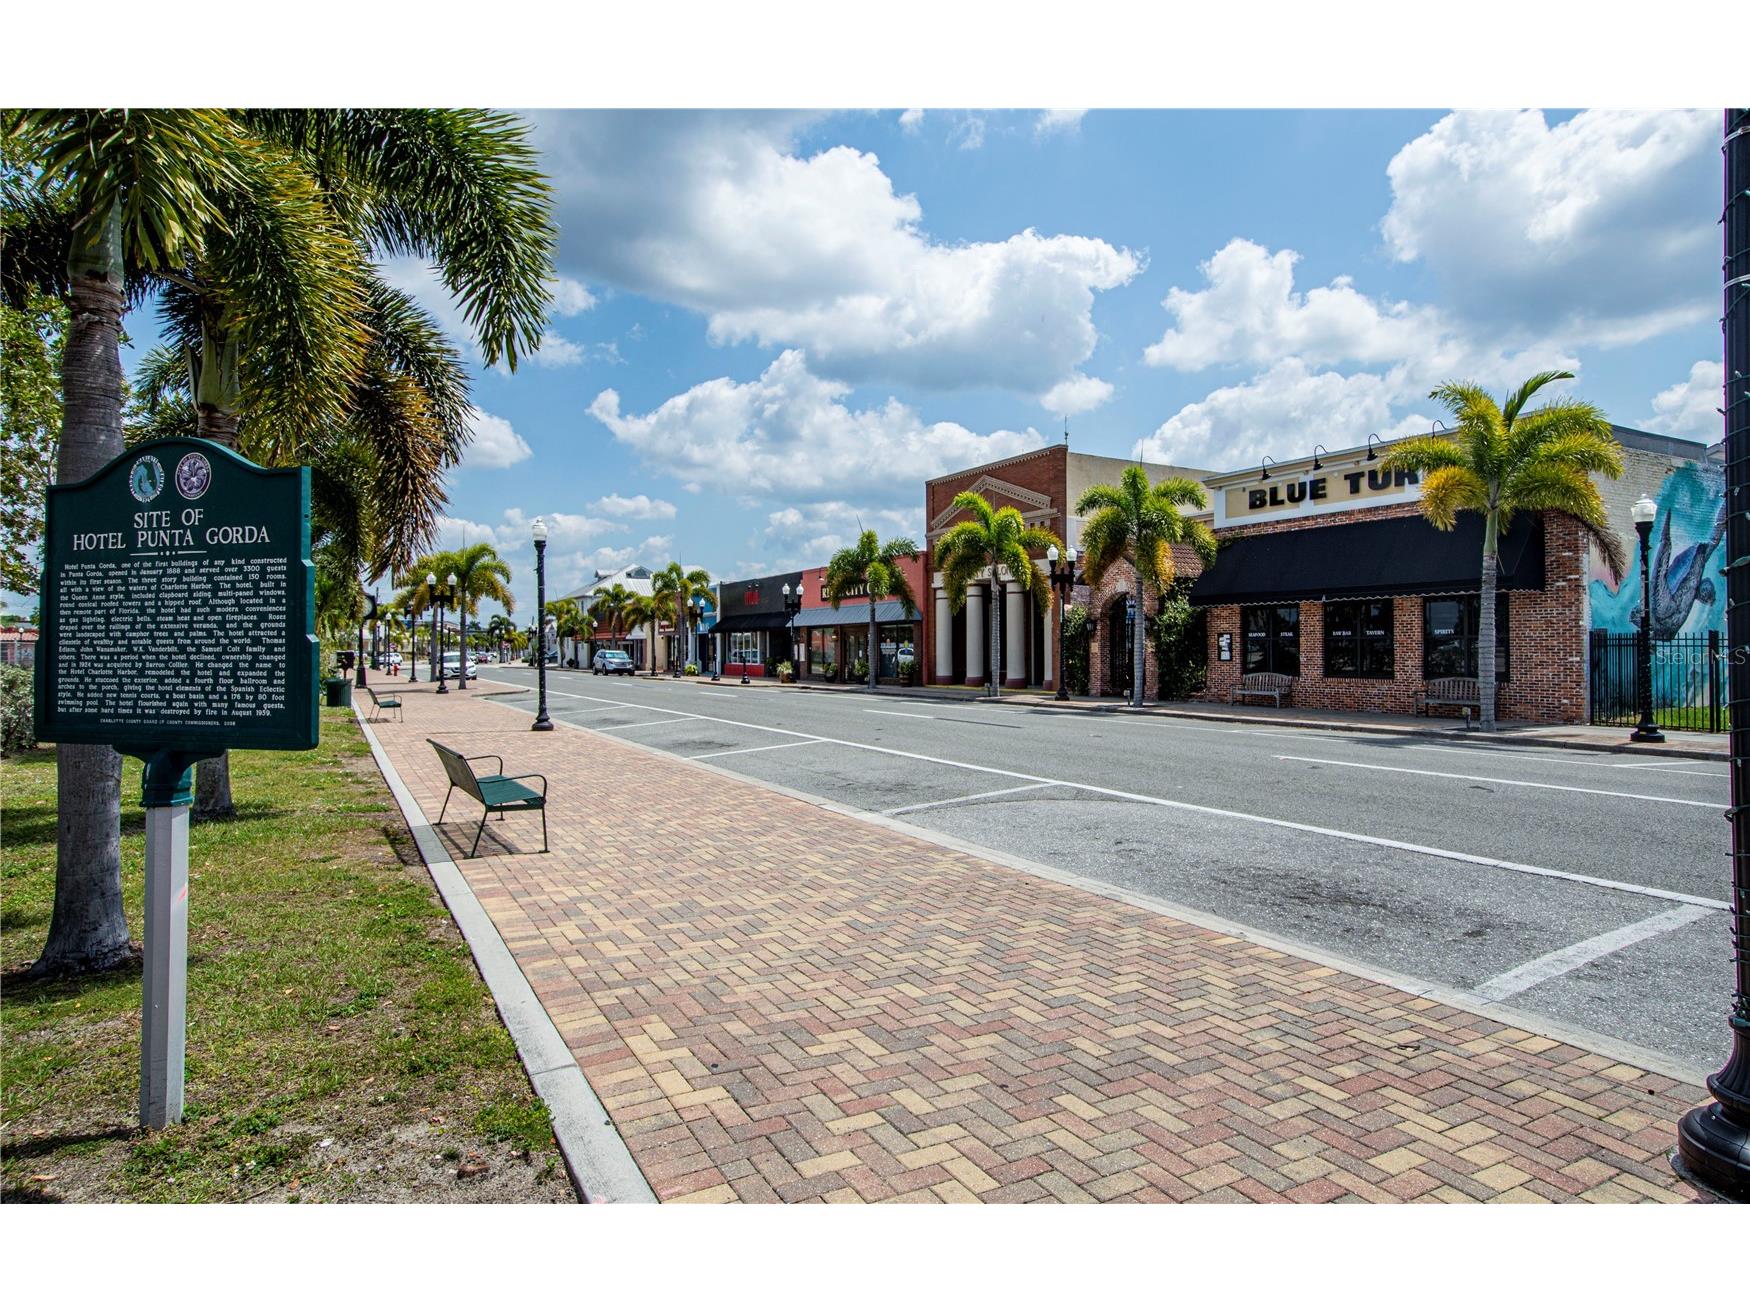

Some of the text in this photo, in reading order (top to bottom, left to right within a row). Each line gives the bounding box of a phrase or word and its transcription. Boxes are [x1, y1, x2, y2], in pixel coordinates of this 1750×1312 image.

[1249, 467, 1419, 509] BLUE TUR
[134, 508, 204, 529] SITE OF
[73, 526, 270, 550] HOTEL PUNTA GORDA
[171, 559, 198, 568] buildings
[250, 557, 287, 565] constructed
[109, 569, 128, 577] opened
[140, 568, 163, 577] January
[167, 567, 181, 575] 1888
[199, 566, 220, 574] served
[243, 565, 260, 573] 3300
[267, 565, 287, 573] guests
[89, 577, 102, 585] first
[161, 576, 178, 584] story
[182, 575, 207, 583] building
[248, 573, 260, 581] 150
[160, 583, 188, 591] Charlotte
[157, 591, 189, 600] clapboard
[123, 599, 141, 607] towers
[165, 599, 184, 607] hipped
[209, 598, 235, 606] Although
[240, 597, 263, 605] located
[94, 608, 106, 616] part
[59, 623, 78, 632] draped
[260, 621, 286, 629] grounds
[126, 630, 150, 639] camphor
[156, 638, 174, 646] guests
[246, 645, 266, 653] family
[120, 654, 139, 662] period
[221, 654, 253, 662] ownership
[259, 654, 286, 662] changed
[107, 661, 132, 669] acquired
[135, 661, 142, 669] by
[207, 661, 233, 669] changed
[237, 669, 268, 677] expanded
[123, 684, 142, 692] giving
[231, 685, 255, 693] Spanish
[245, 693, 253, 701] by
[57, 698, 83, 706] swimming
[172, 700, 189, 708] again
[161, 708, 189, 716] destroyed
[195, 709, 201, 717] by
[232, 709, 252, 717] August
